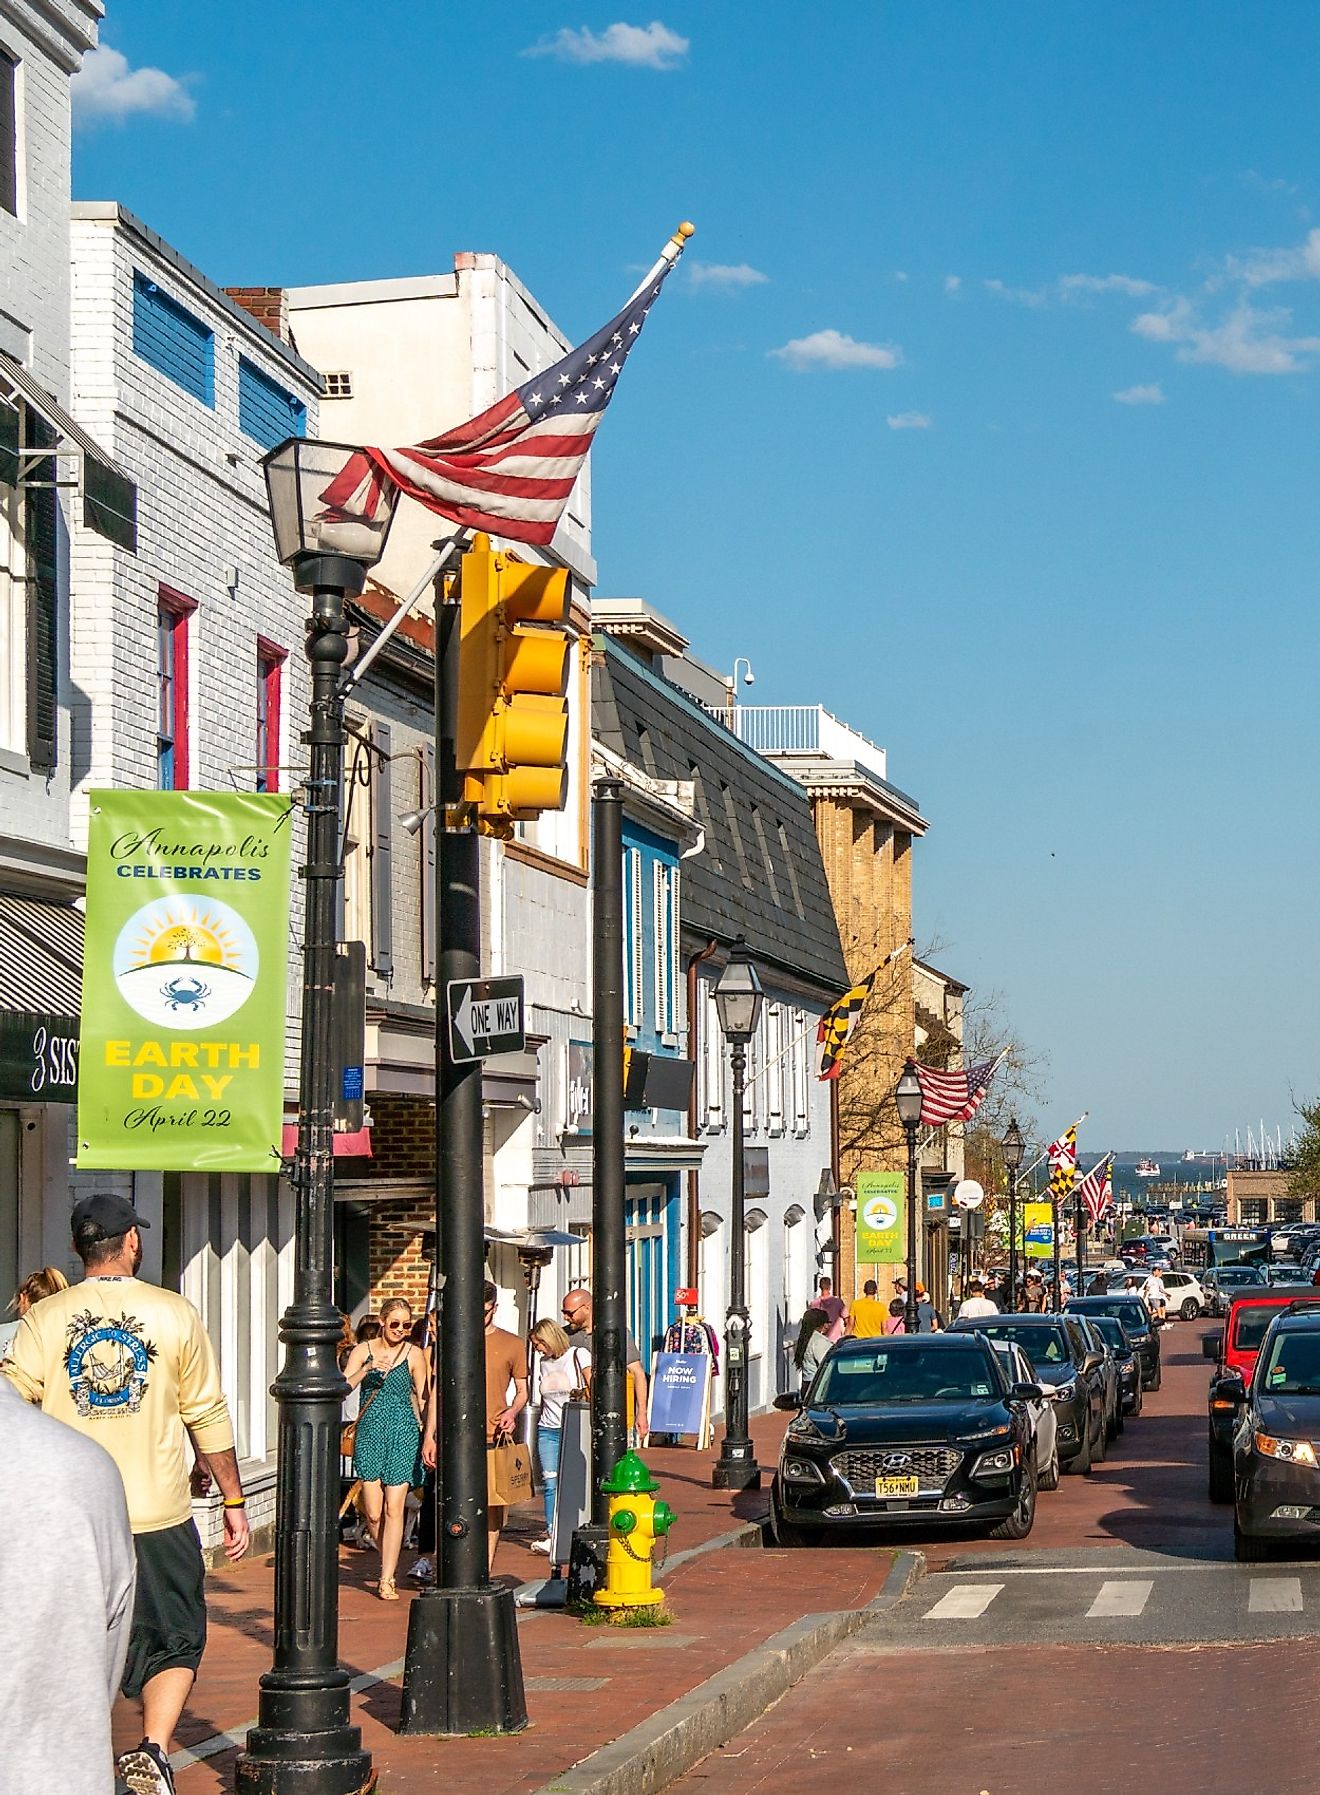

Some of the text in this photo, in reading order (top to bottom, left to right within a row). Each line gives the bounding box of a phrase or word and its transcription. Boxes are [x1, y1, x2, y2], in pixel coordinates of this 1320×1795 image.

[110, 828, 269, 866] Annapolis
[117, 864, 262, 881] CELEBRATES
[470, 1001, 518, 1034] ONE WAY
[50, 1037, 80, 1086] SIS
[105, 1040, 260, 1069] EARTH
[132, 1073, 234, 1101] DAY
[123, 1105, 232, 1133] April 22
[861, 1231, 898, 1239] EARTH
[867, 1239, 893, 1247] DAY
[1223, 1232, 1257, 1240] GREEN
[120, 1332, 147, 1372] STRESS
[662, 1375, 697, 1384] HIRING
[668, 1366, 694, 1375] NOW
